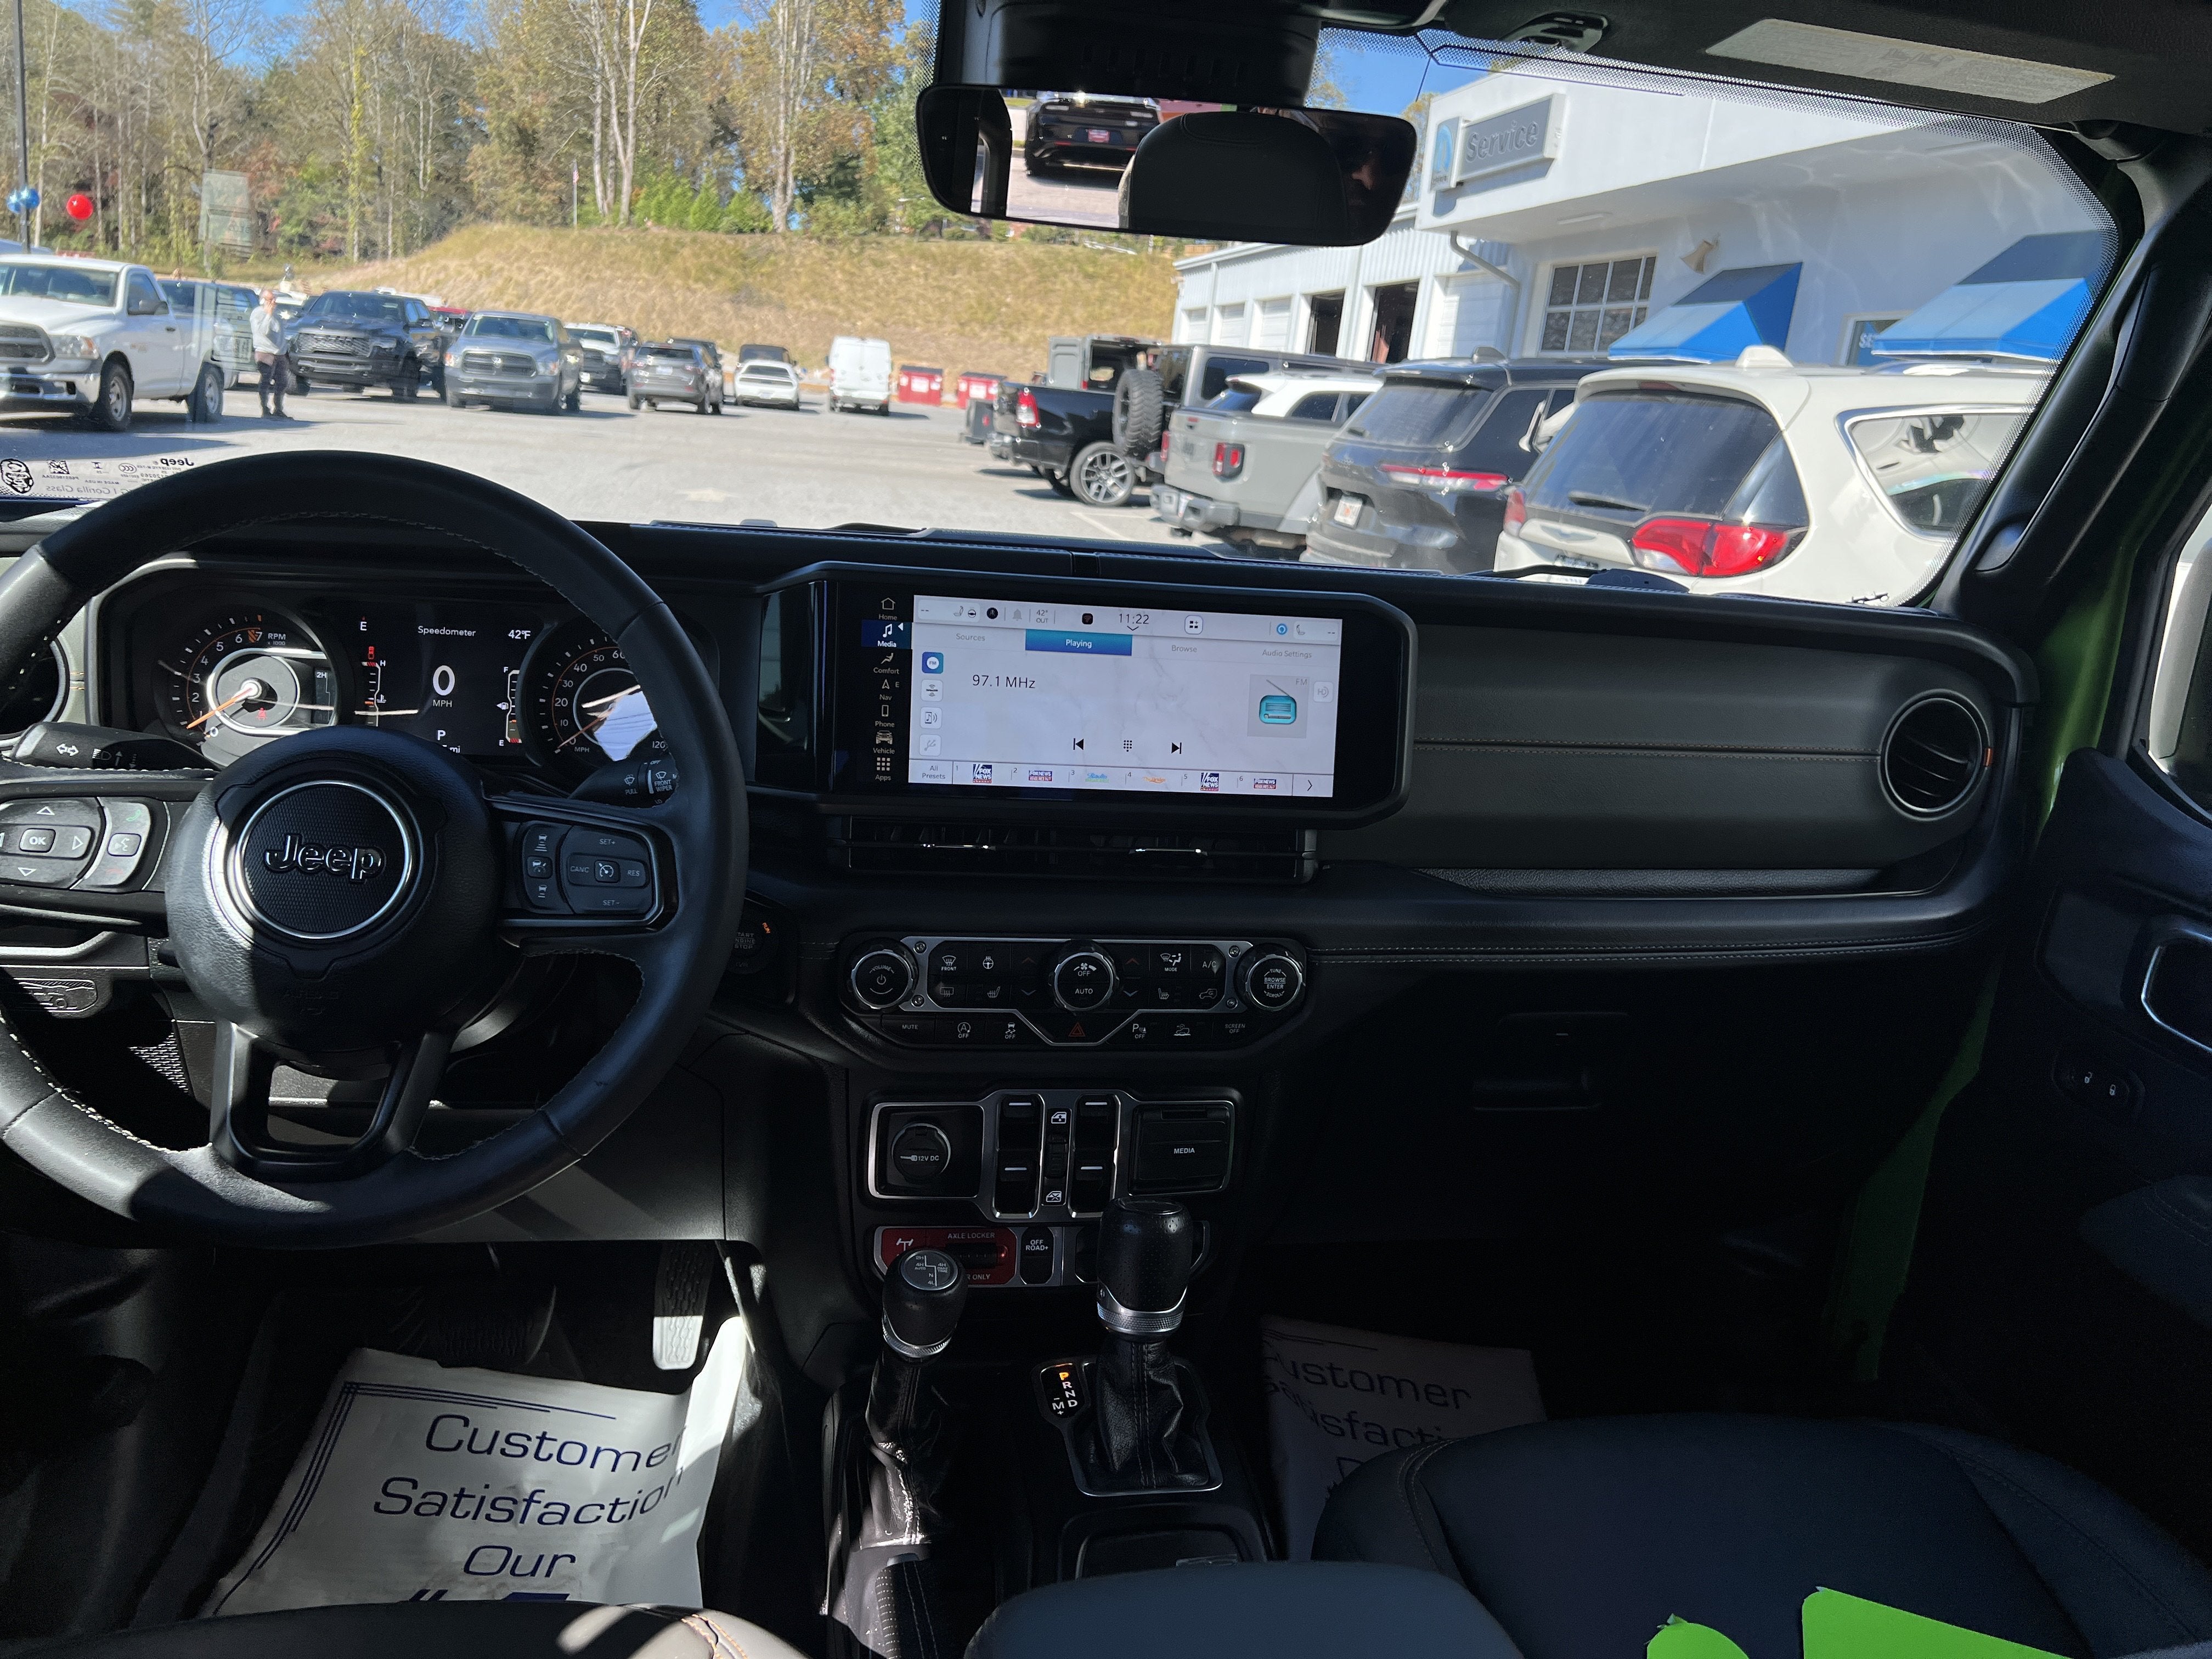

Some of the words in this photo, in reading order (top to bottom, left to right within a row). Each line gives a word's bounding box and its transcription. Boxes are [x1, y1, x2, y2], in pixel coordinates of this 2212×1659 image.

[1465, 120, 1540, 162] Service
[1119, 613, 1149, 624] 11:22
[360, 621, 367, 631] E
[417, 625, 476, 636] Speedometer
[235, 634, 242, 643] 6
[256, 631, 263, 641] 7
[956, 633, 986, 641] Sources
[216, 642, 224, 651] 5
[1065, 639, 1092, 648] Playing
[1171, 645, 1198, 653] Browse
[1284, 651, 1312, 659] Settings
[201, 656, 208, 665] 4
[573, 664, 587, 672] 40
[193, 674, 201, 684] 3
[432, 665, 455, 696] 0
[972, 674, 1000, 687] 97.1
[1006, 676, 1035, 689] MHz
[191, 693, 200, 702] 2
[555, 698, 568, 707] 20
[210, 726, 219, 737] 0
[437, 730, 446, 741] P
[652, 741, 665, 749] 120
[29, 836, 46, 845] OK
[265, 834, 385, 881] Jeep
[1202, 960, 1217, 968] A/C
[1059, 1372, 1069, 1380] P
[1065, 1390, 1076, 1398] N
[1052, 1401, 1065, 1410] M
[464, 1544, 575, 1578] Our
